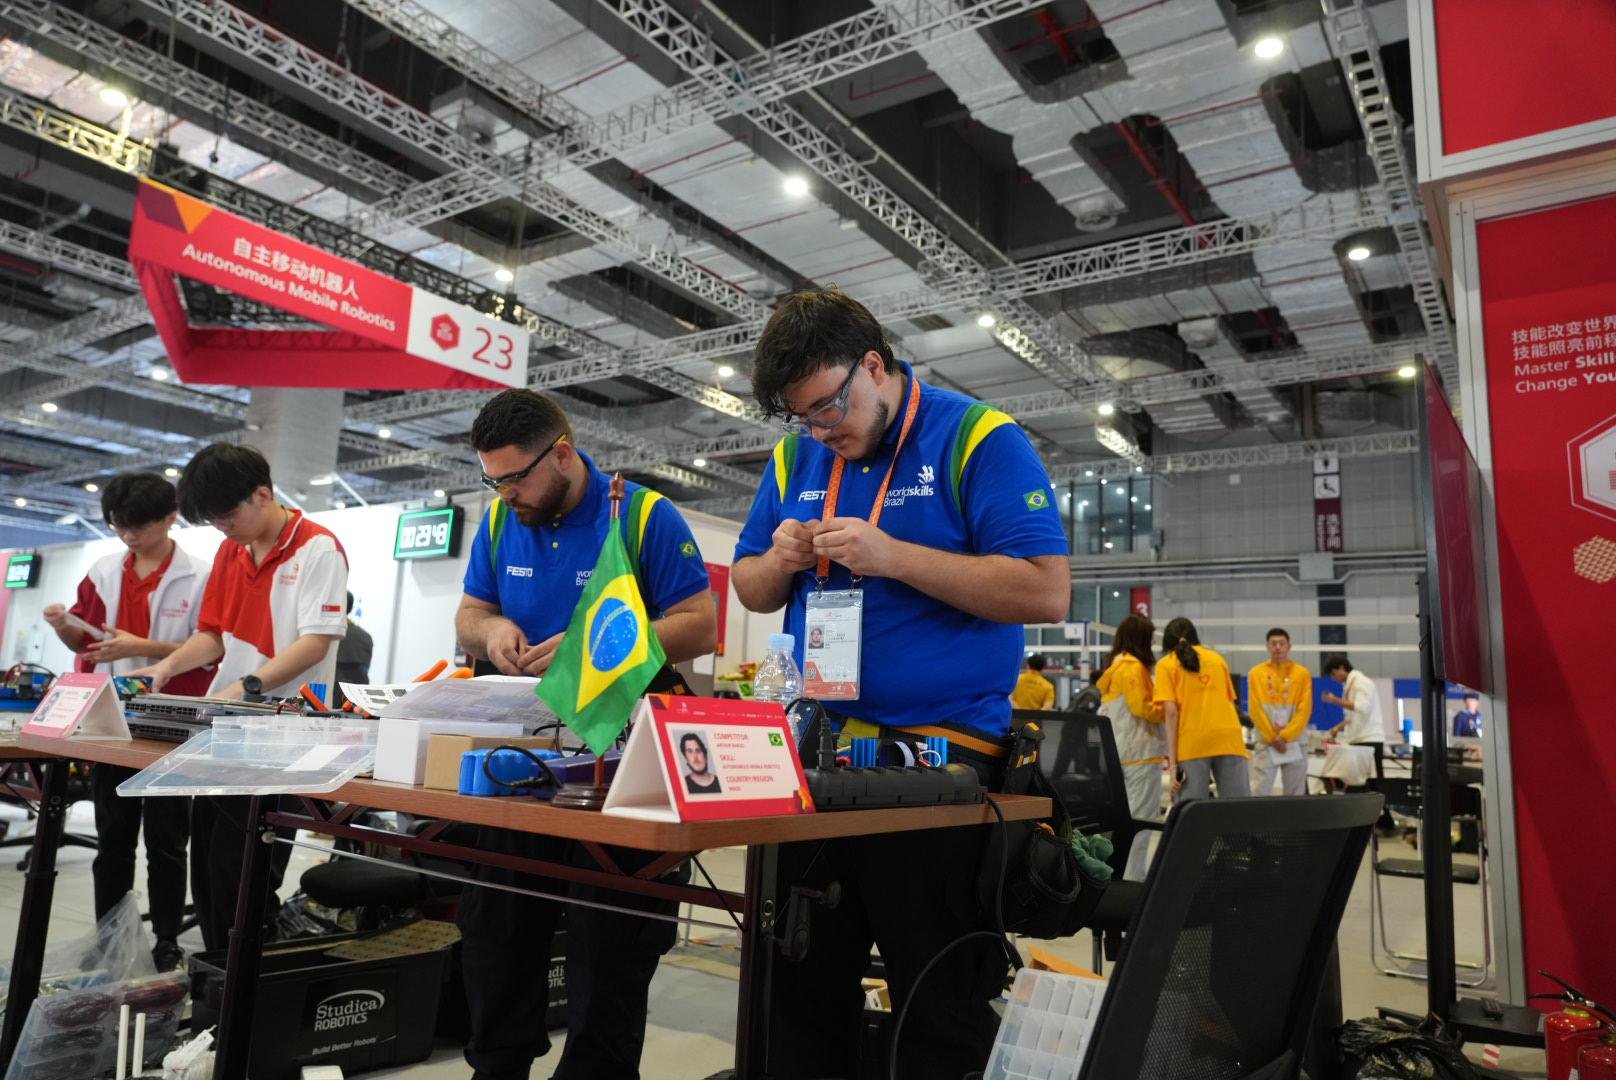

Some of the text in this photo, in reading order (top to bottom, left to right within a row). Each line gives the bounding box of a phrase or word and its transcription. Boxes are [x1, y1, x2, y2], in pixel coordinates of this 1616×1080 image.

[233, 237, 359, 300] 自主移动机器人
[182, 243, 396, 332] Autonomous Mobile Robotics
[1512, 315, 1616, 345] 技能改变世界
[472, 327, 514, 370] 23
[1514, 351, 1616, 376] Master Skill
[1515, 372, 1616, 393] Change You
[798, 490, 828, 502] FEST
[884, 497, 905, 508] Brazil
[506, 566, 534, 577] FESTO
[316, 1000, 378, 1020] Studica
[314, 1012, 368, 1032] ROBOTICS
